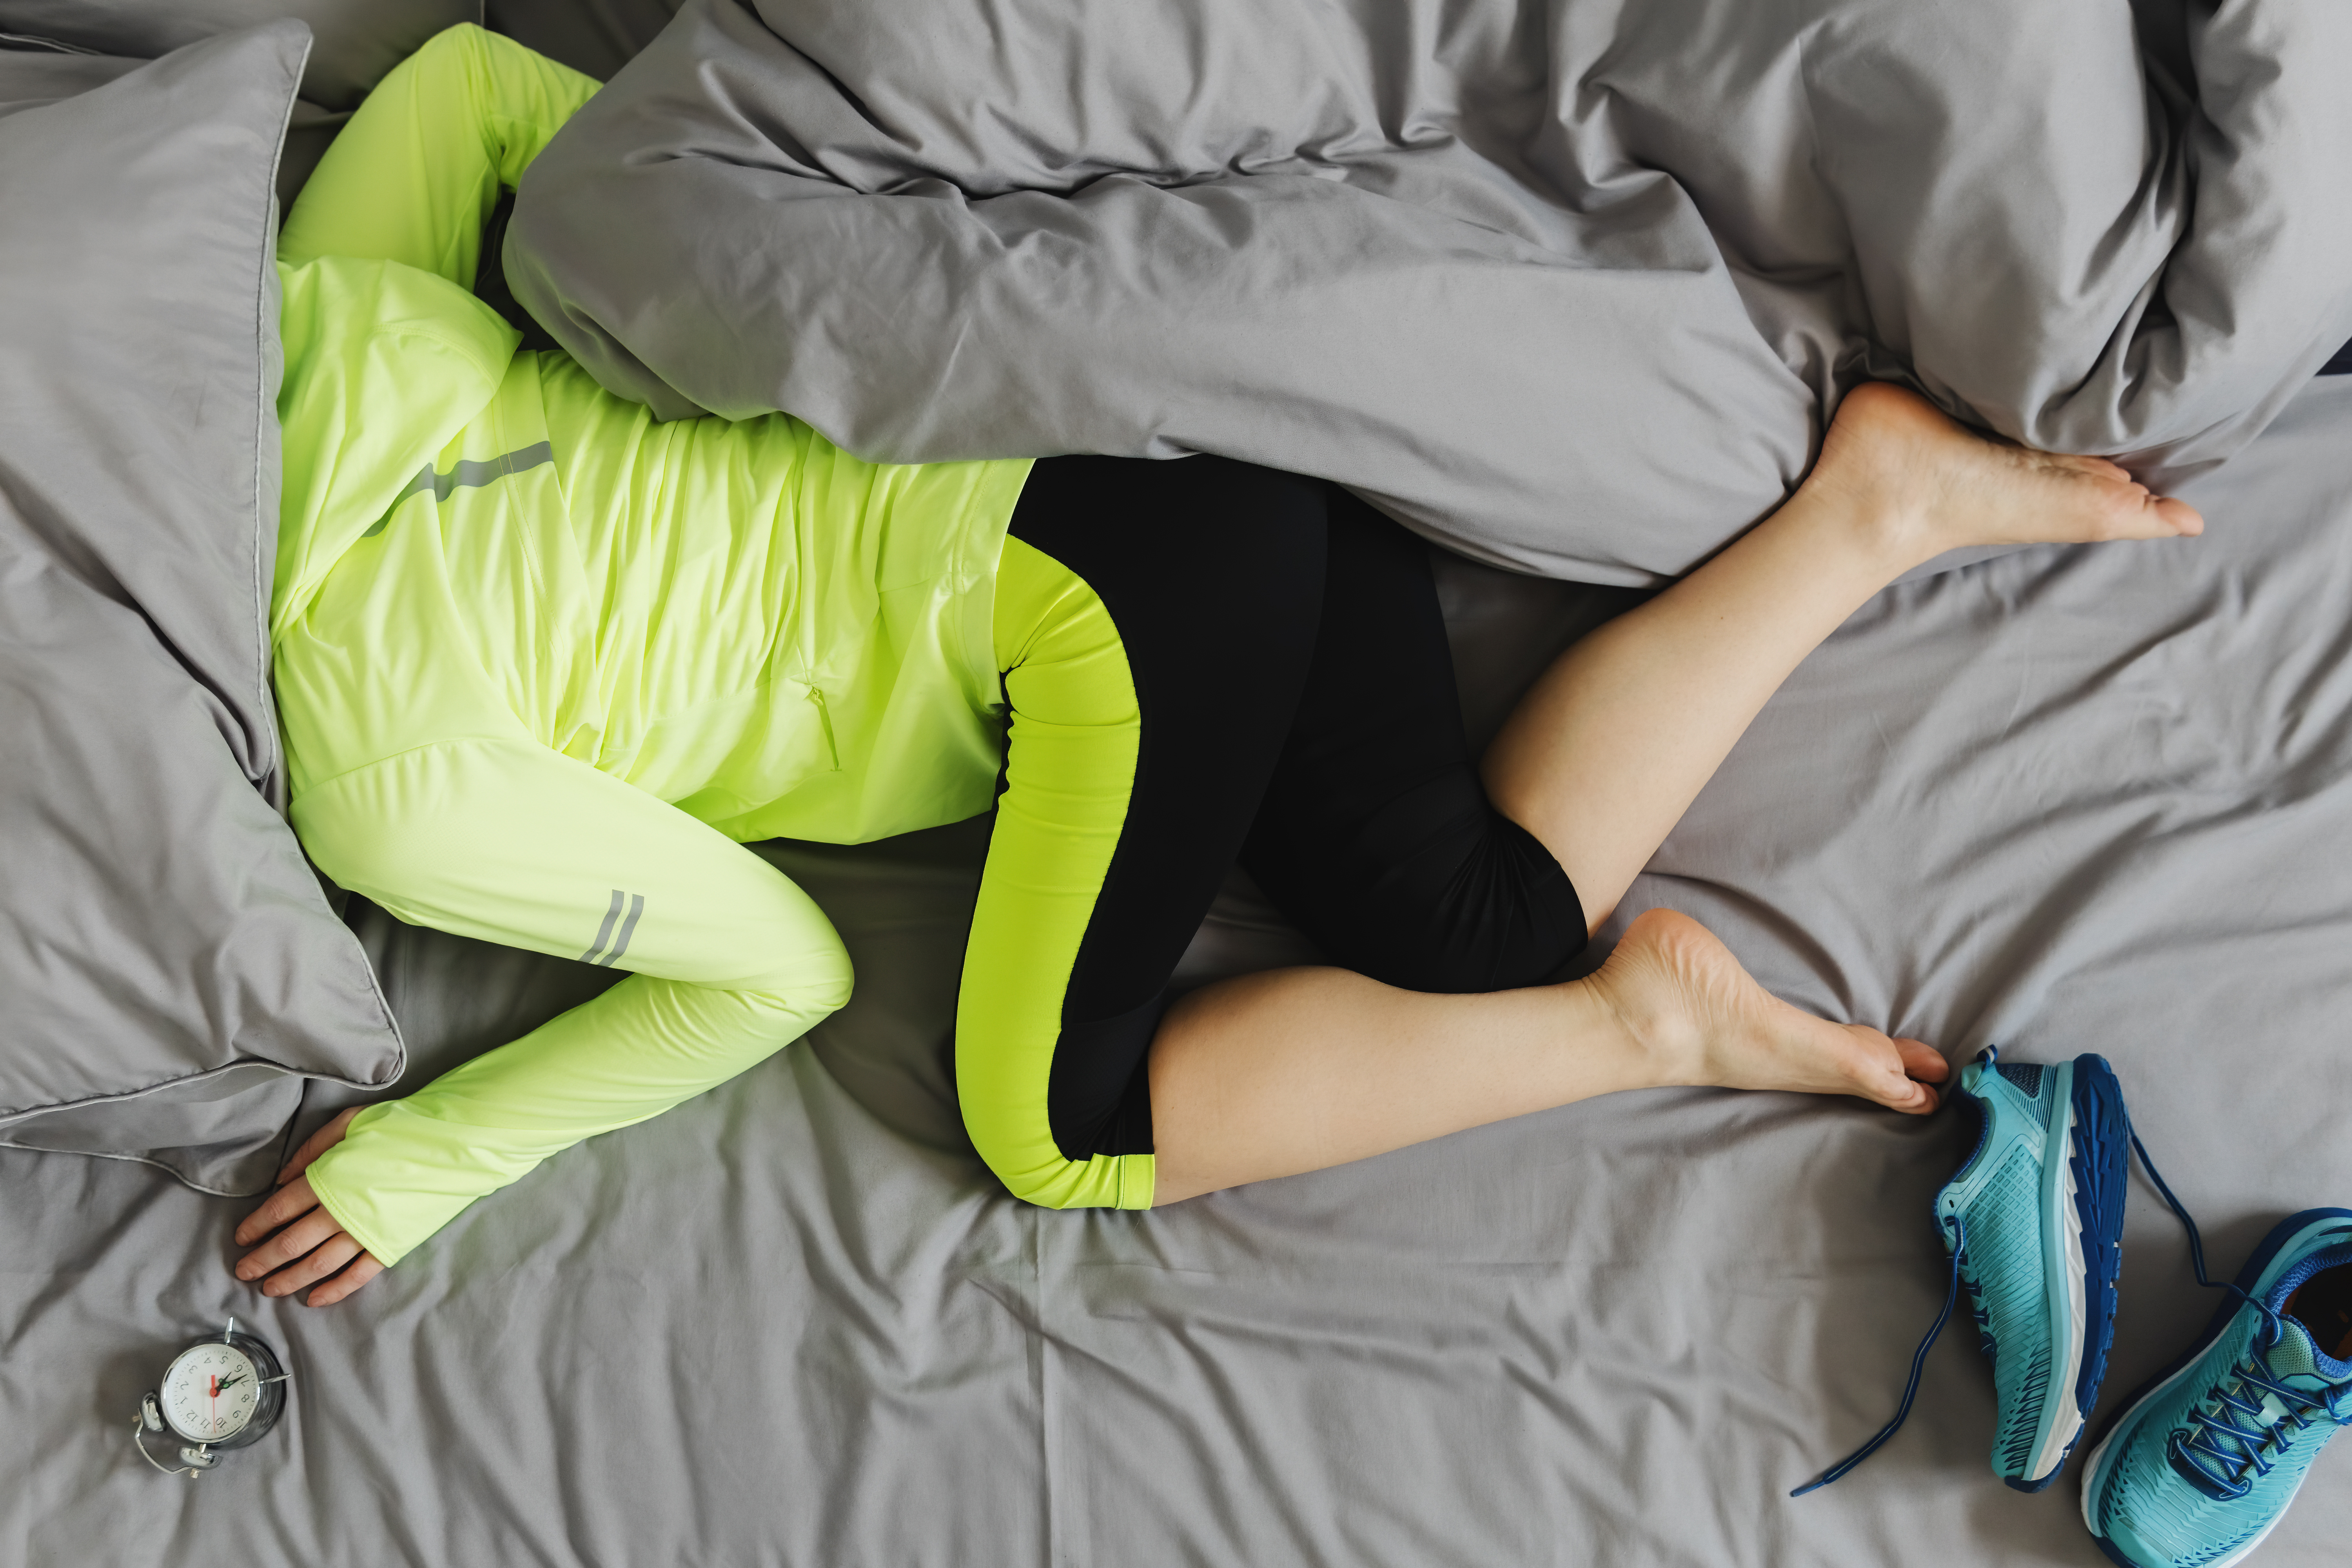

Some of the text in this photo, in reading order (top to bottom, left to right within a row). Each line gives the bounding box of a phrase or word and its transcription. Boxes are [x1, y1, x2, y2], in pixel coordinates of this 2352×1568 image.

[219, 1356, 229, 1365] 5
[189, 1365, 198, 1374] 3
[234, 1364, 243, 1373] 6
[180, 1381, 189, 1390] 2
[240, 1379, 250, 1387] 7
[241, 1394, 250, 1403] 8
[186, 1409, 198, 1422] 12
[232, 1410, 241, 1418] 9
[200, 1417, 211, 1429] 11
[215, 1417, 228, 1429] 10
